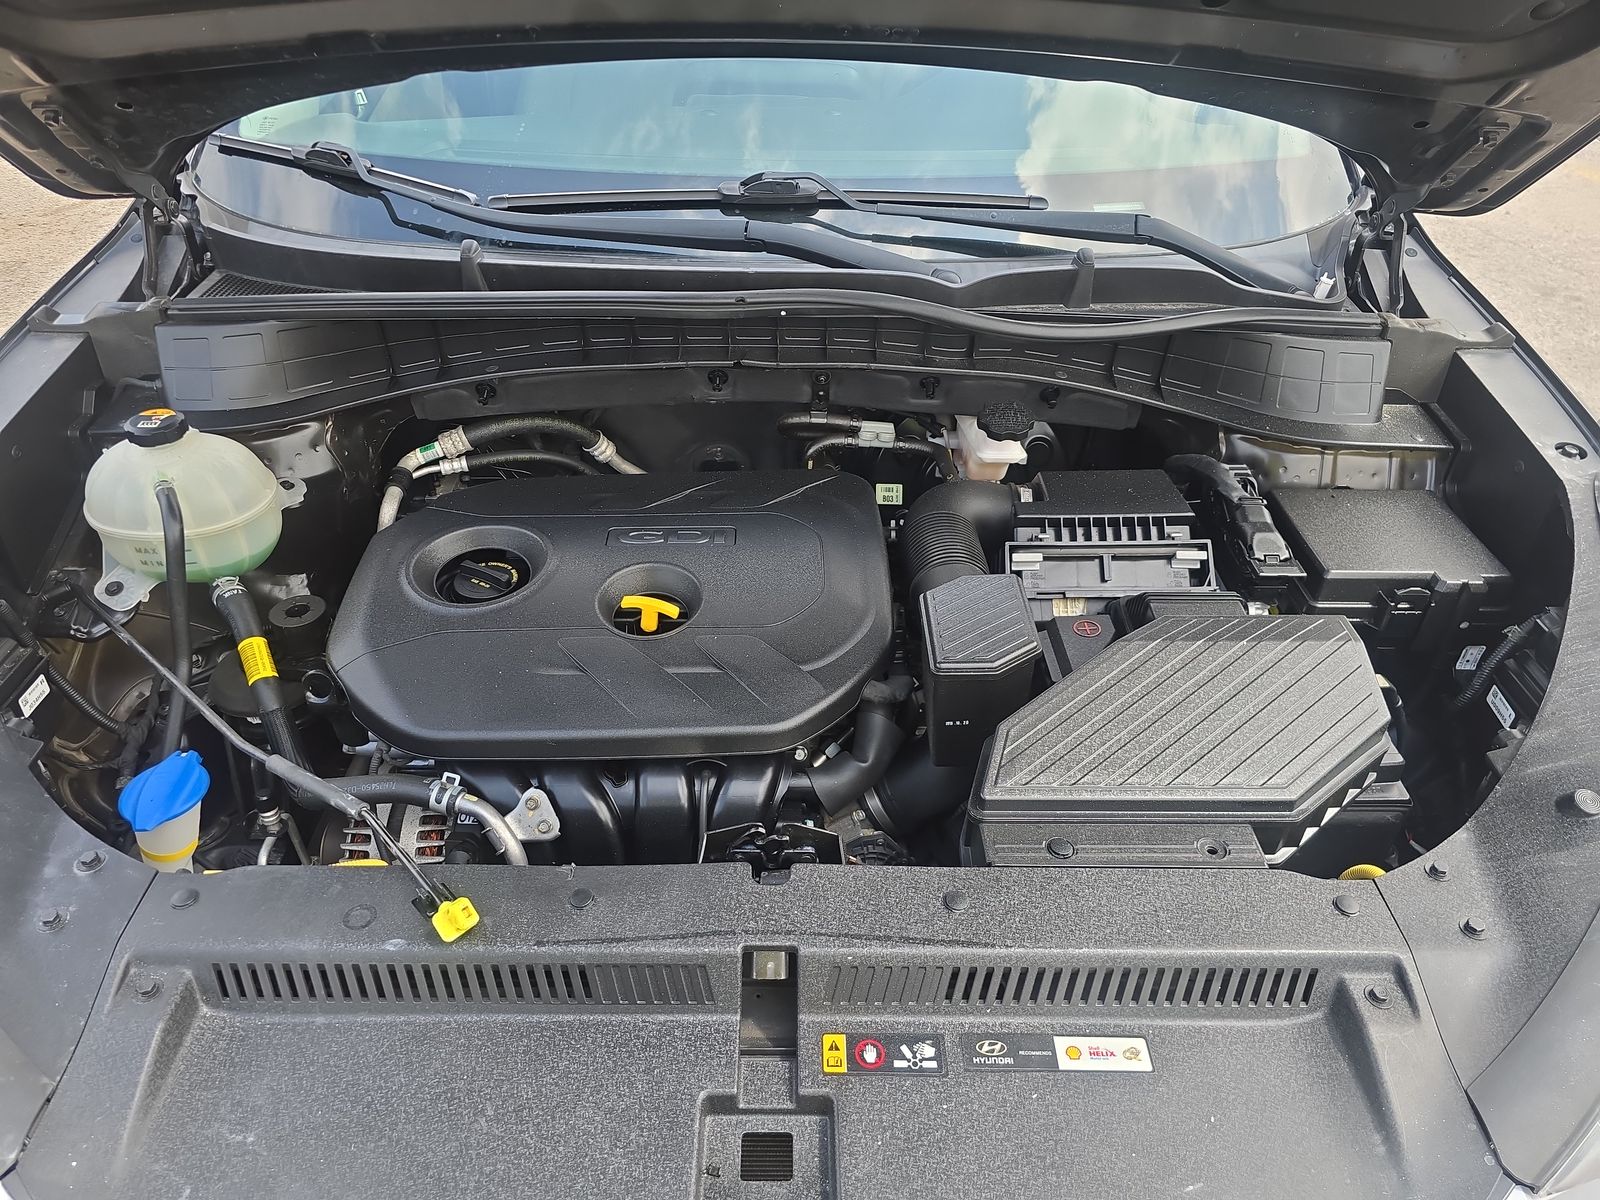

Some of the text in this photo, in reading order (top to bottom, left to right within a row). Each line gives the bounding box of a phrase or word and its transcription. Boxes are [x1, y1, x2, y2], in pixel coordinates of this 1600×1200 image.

[618, 530, 726, 544] GDI
[134, 546, 160, 555] MAX
[139, 559, 164, 567] MIN
[973, 1056, 1014, 1065] HYUNDAI
